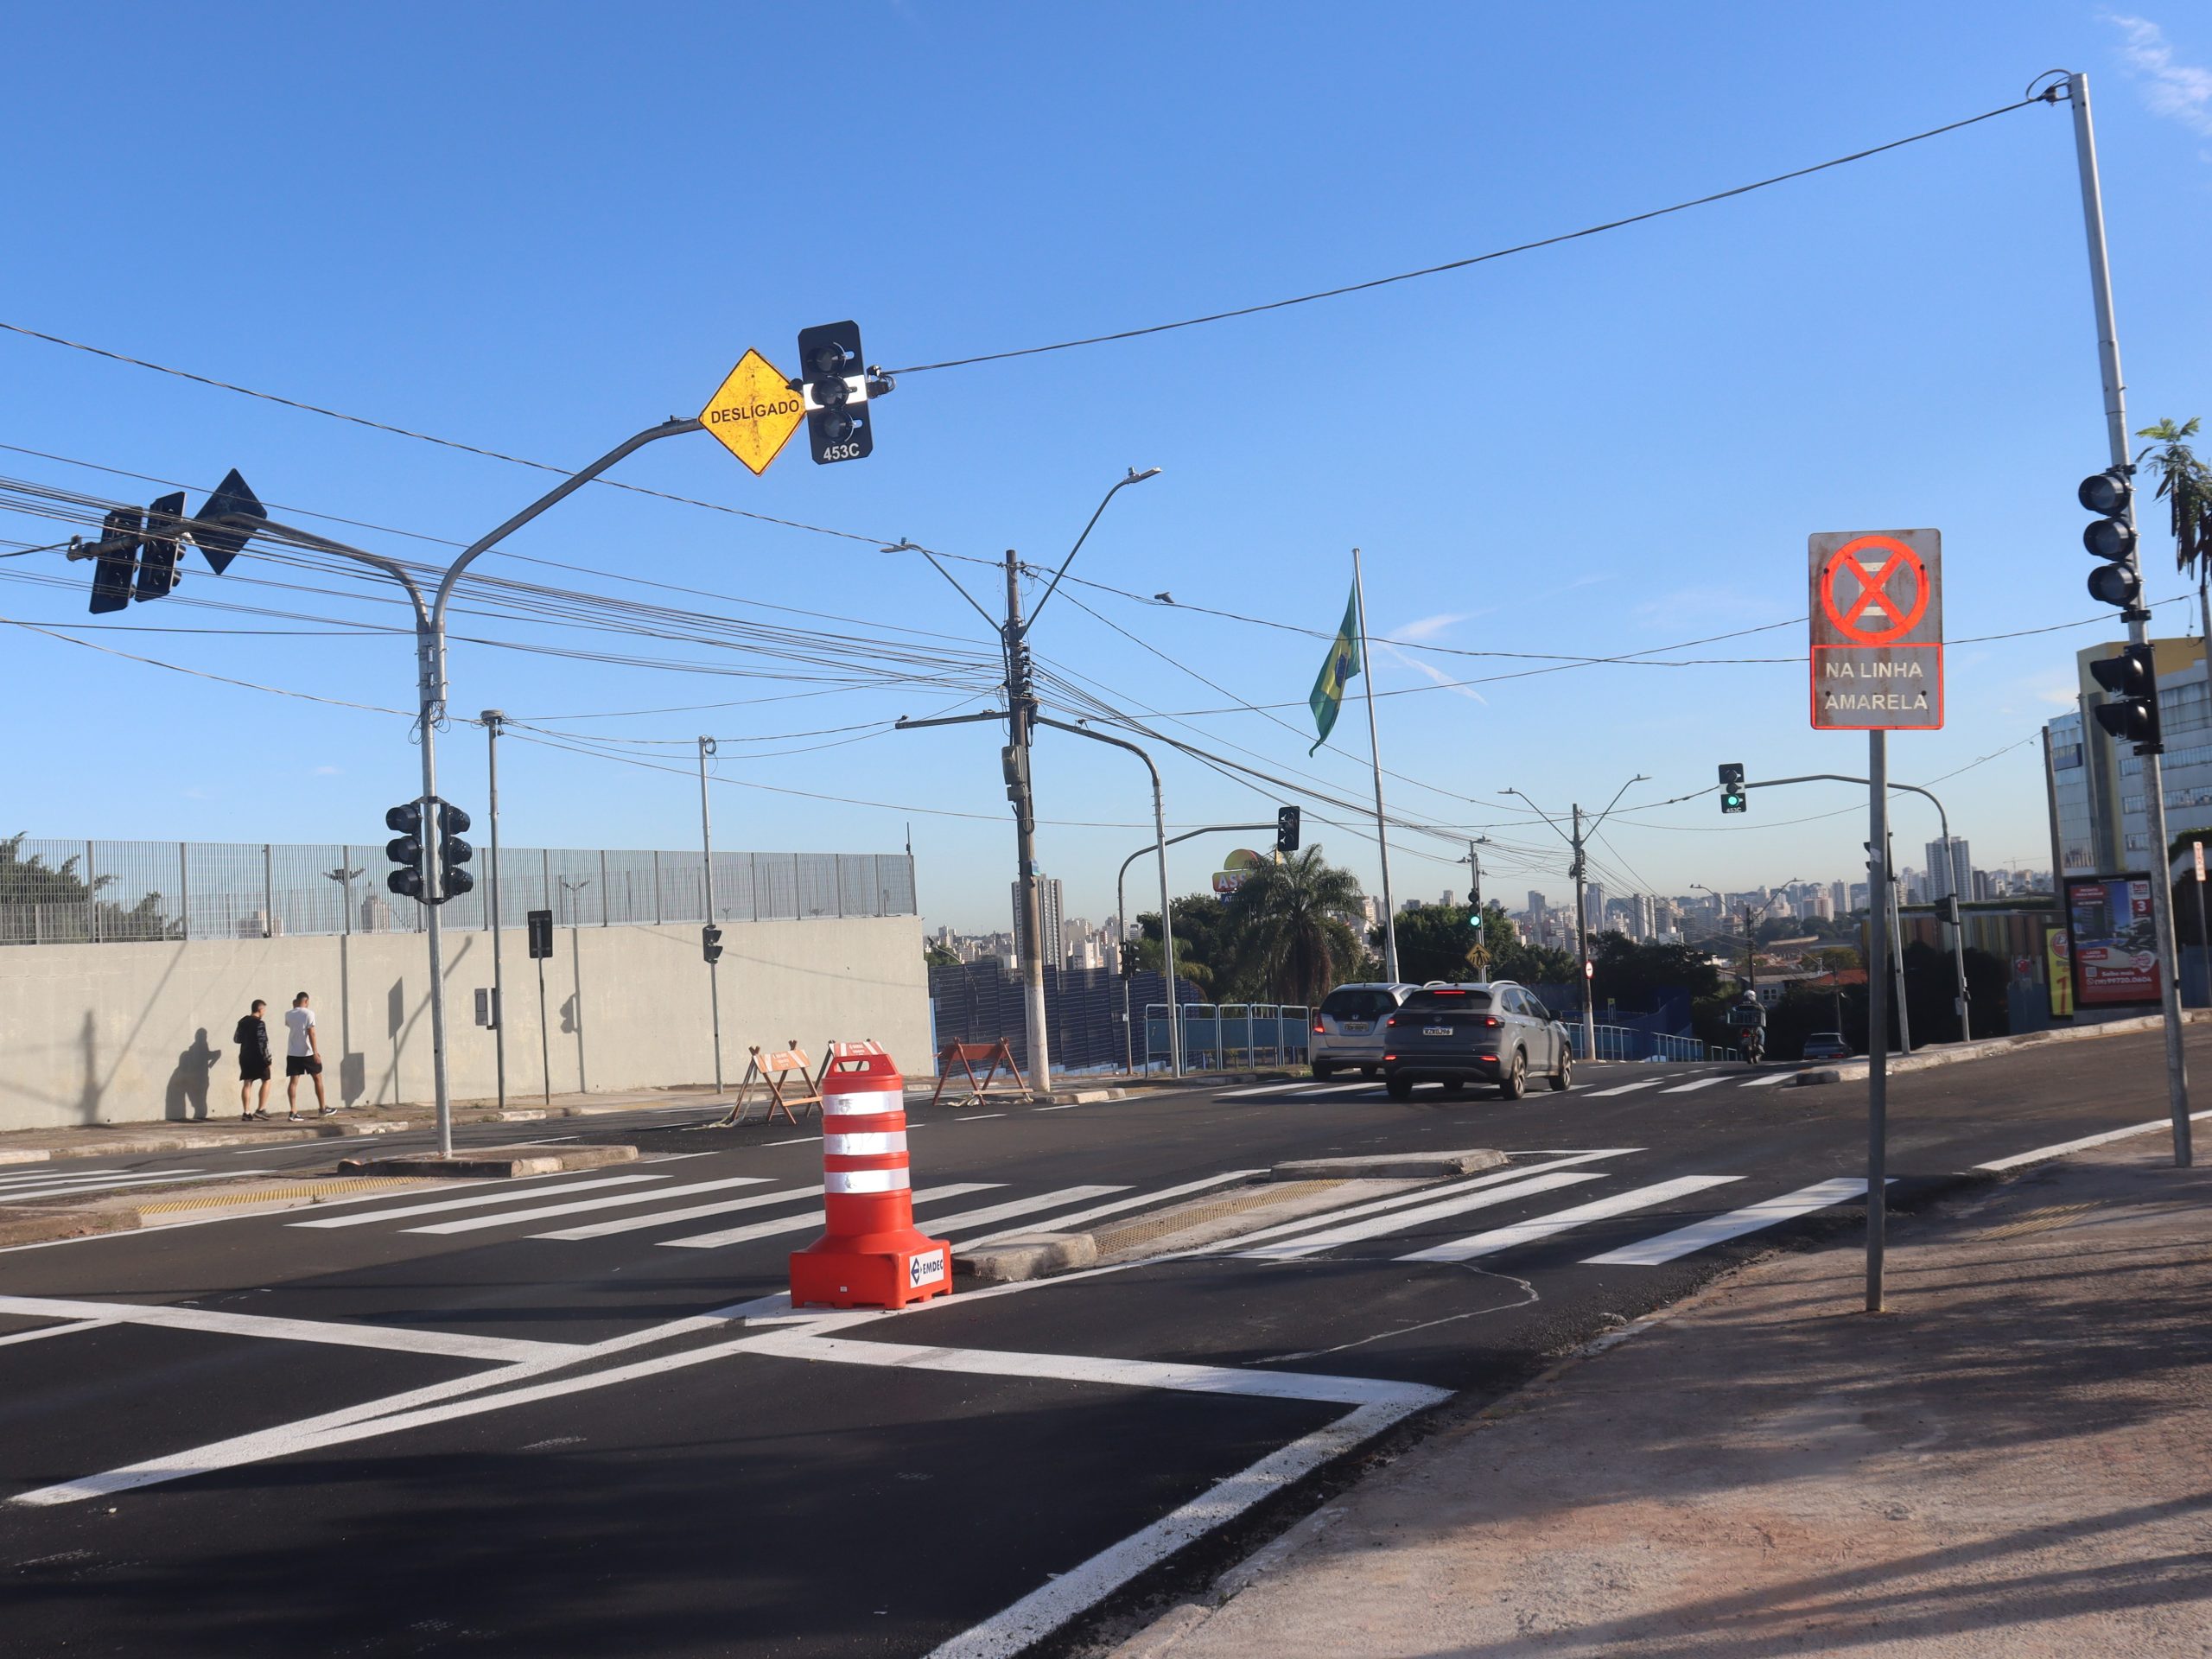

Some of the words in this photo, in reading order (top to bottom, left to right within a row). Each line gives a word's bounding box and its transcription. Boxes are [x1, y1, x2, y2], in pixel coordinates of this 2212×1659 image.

[711, 399, 800, 423] DESLIGADO
[823, 442, 860, 461] 453C
[1826, 663, 1854, 678] NA
[1860, 662, 1923, 678] LINHA
[1825, 694, 1929, 710] AMARELA
[2137, 900, 2146, 912] 3
[923, 1258, 944, 1274] EMDEC
